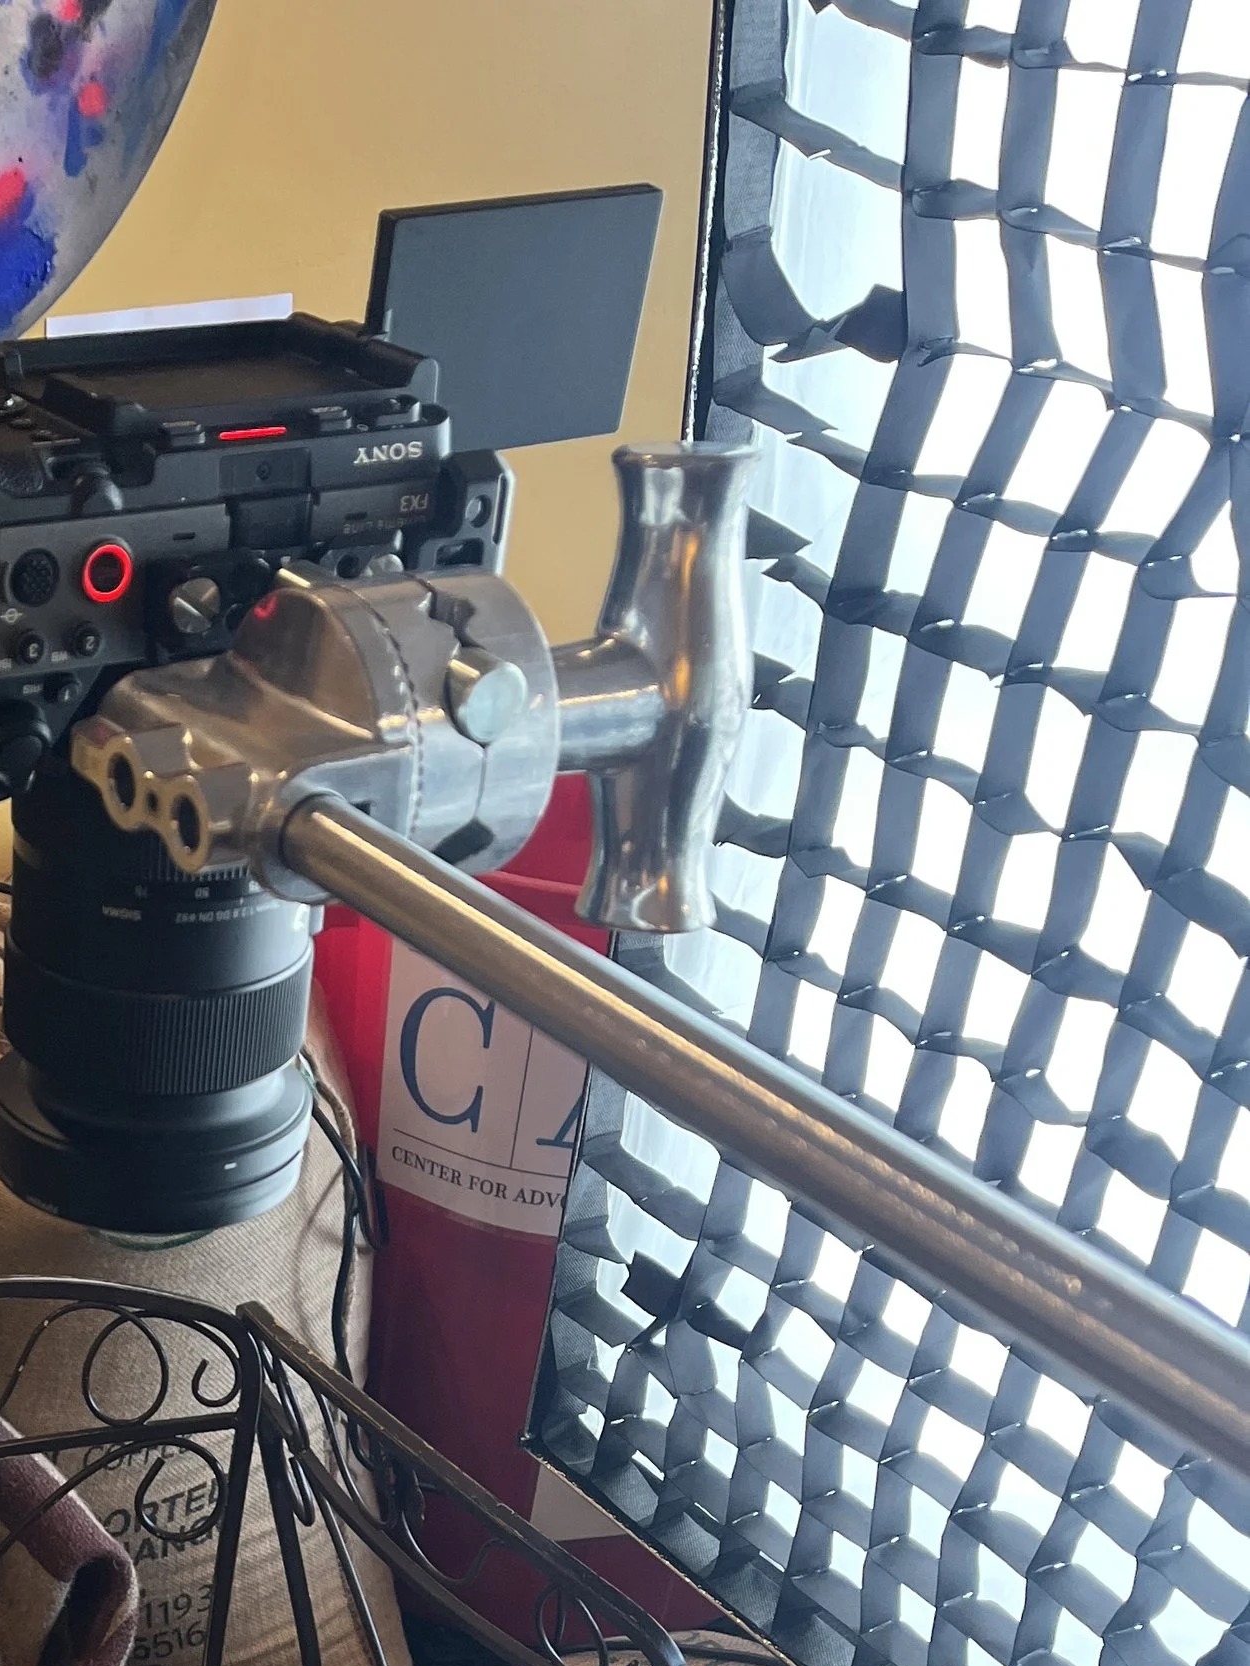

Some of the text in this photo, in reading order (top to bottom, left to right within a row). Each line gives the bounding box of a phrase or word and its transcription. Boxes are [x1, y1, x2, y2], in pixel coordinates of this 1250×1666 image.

[354, 441, 423, 464] SONY
[401, 493, 428, 512] FX3
[400, 987, 496, 1134] C
[391, 1146, 462, 1187] CENTER
[468, 1175, 508, 1199] FOR
